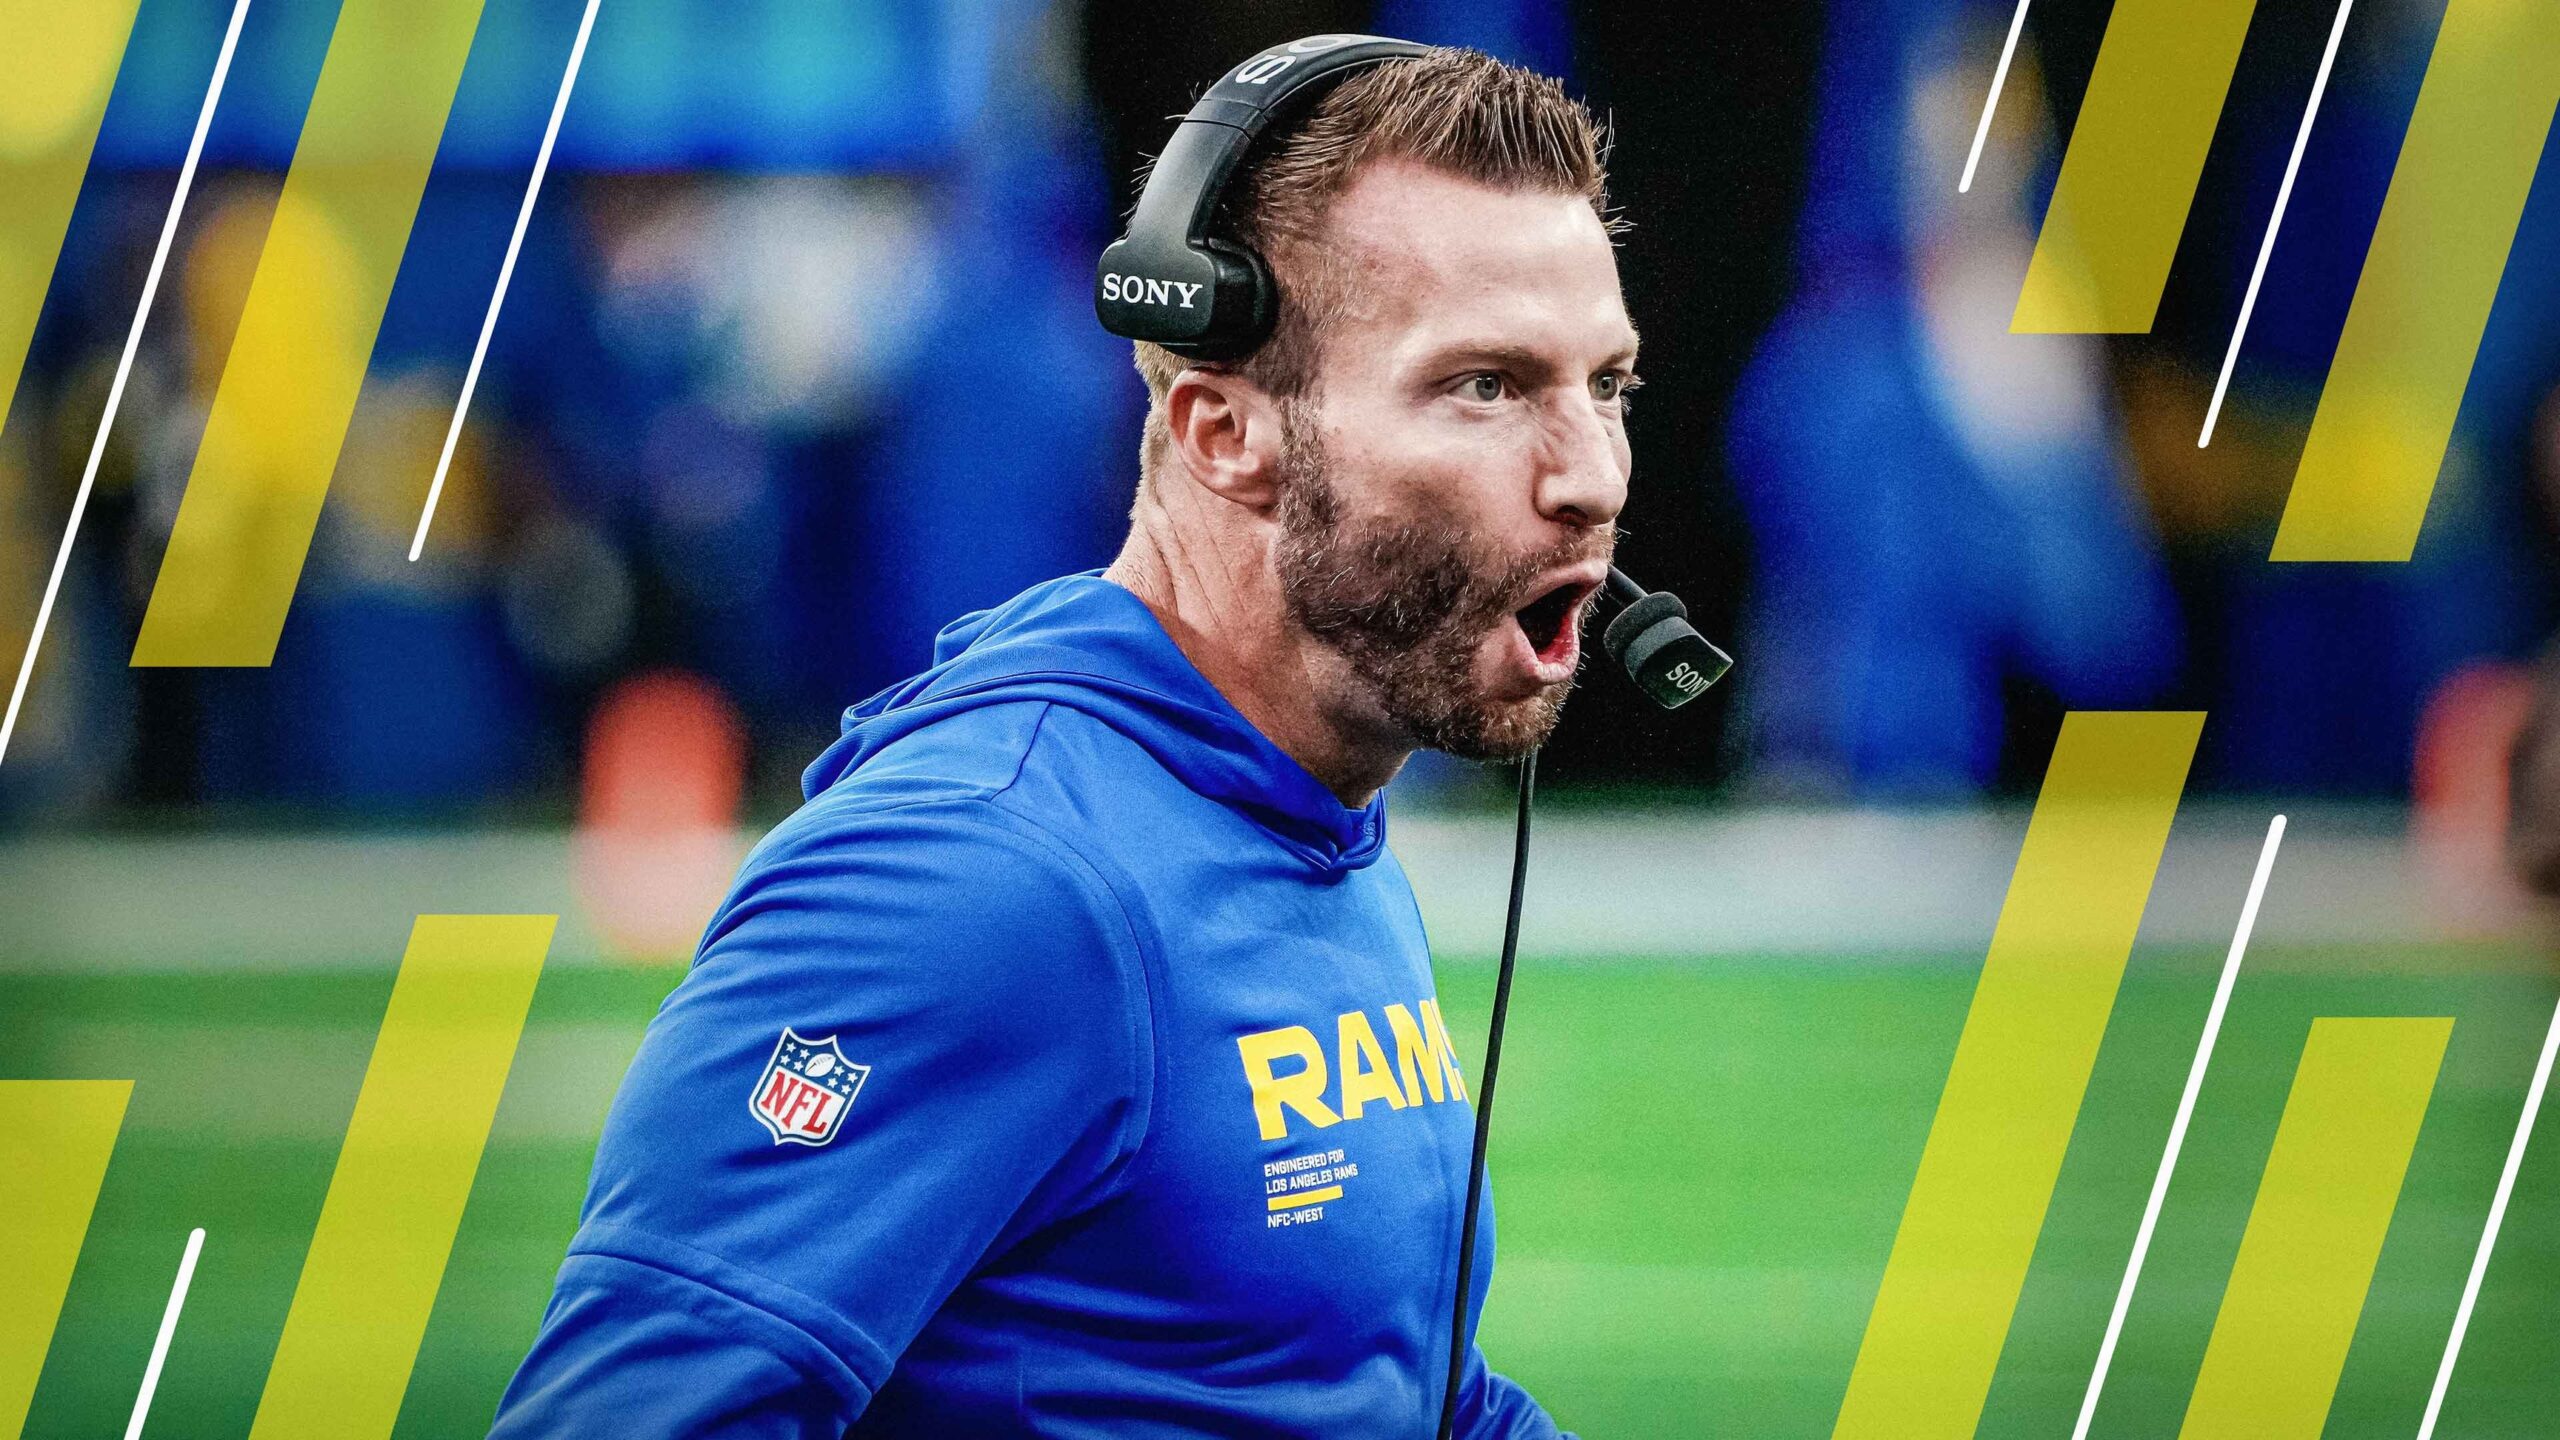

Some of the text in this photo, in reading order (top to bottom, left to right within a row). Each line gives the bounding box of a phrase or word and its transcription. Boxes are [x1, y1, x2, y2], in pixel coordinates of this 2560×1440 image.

[1235, 35, 1350, 84] SO
[1102, 272, 1203, 309] SONY
[1665, 662, 1711, 698] SON
[760, 1071, 832, 1134] NFL
[1264, 1148, 1345, 1177] ENGINEERED FOR
[1266, 1163, 1358, 1194] LOS ANGELES RAMS
[1267, 1206, 1323, 1228] NFC-WEST
